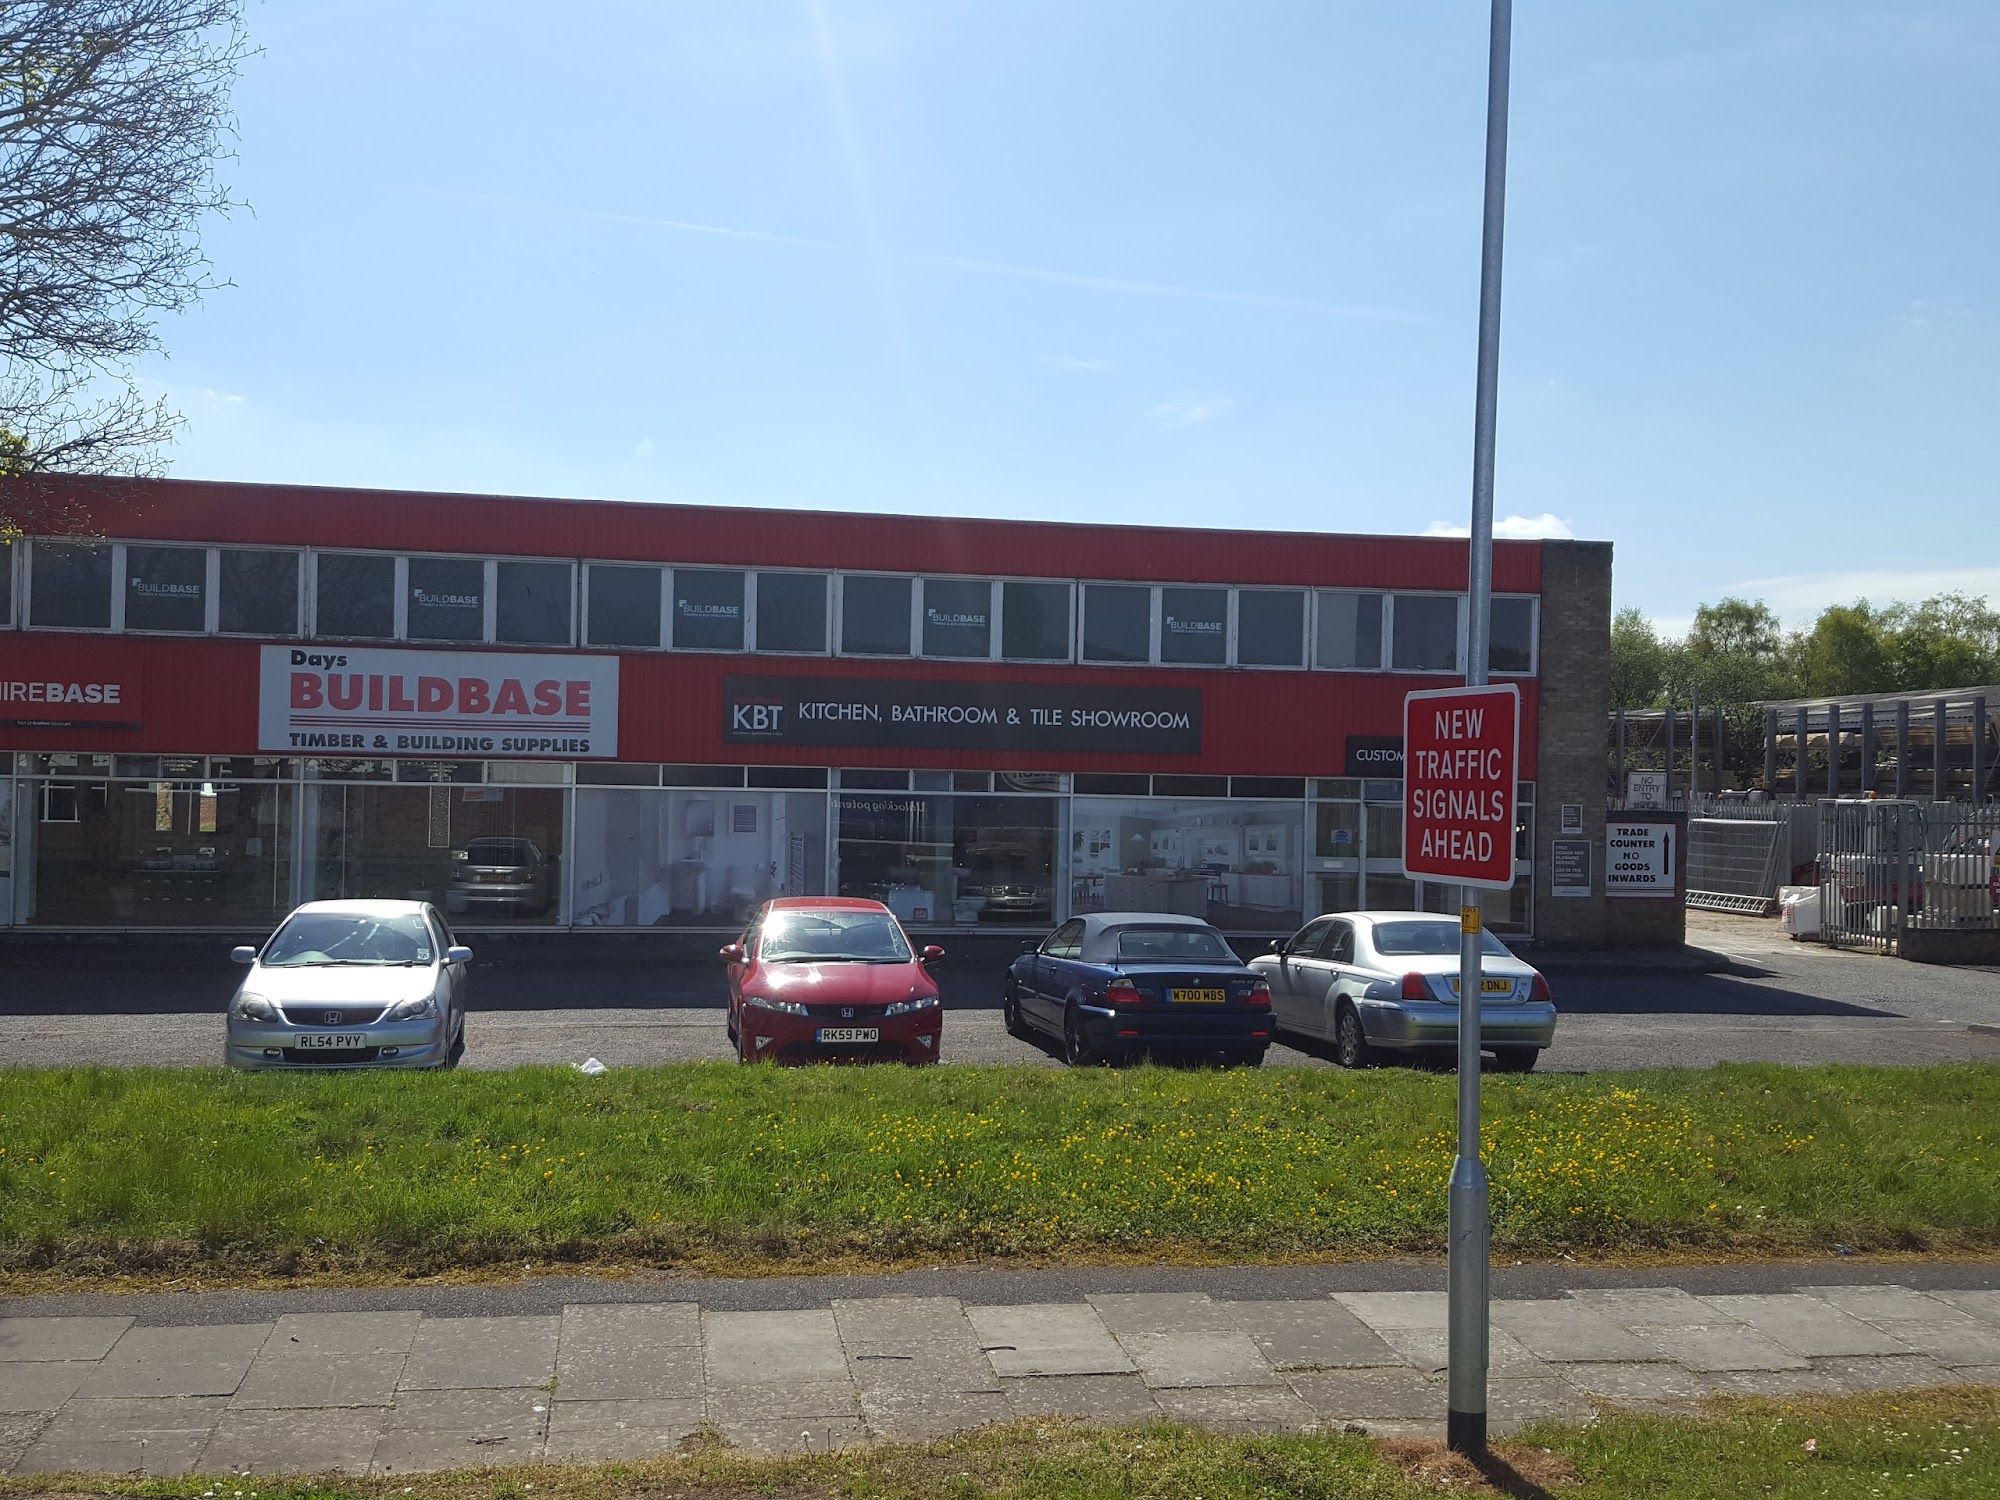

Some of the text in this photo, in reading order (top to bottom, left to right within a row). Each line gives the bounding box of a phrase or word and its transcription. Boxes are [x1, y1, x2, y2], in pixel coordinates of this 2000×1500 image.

[137, 583, 200, 593] BUILDBASE
[419, 594, 479, 604] BUILDBASE
[683, 605, 739, 614] BUILDBASE
[932, 613, 986, 622] BUILDBASE
[1170, 621, 1222, 630] BUILDBASE
[291, 649, 348, 671] Days
[0, 681, 121, 704] IREBASE
[289, 672, 591, 716] BUILDBASE
[733, 704, 783, 730] KBT
[799, 702, 1190, 729] KITCHEN, BATHROOM & TILE SHOWROOM
[1435, 708, 1484, 740] NEW
[289, 732, 590, 752] TIMBER & BUILDING SUPPLIES
[1416, 748, 1502, 780] TRAFFIC
[1641, 776, 1654, 784] NO
[1633, 784, 1660, 793] ENTRY
[1641, 792, 1652, 800] TO
[1412, 788, 1505, 822] SIGNALS
[1616, 828, 1650, 836] TRADE
[1420, 828, 1493, 862] AHEAD
[1610, 839, 1655, 848] COUNTER
[1623, 852, 1640, 860] NO
[1614, 863, 1650, 871] GOODS
[1608, 874, 1656, 883] INWARDS
[1487, 980, 1507, 990] DNJ
[1173, 990, 1224, 1000] W700 MBS
[823, 1029, 877, 1040] RK59 PWO
[300, 1035, 361, 1048] RL54 PVY
